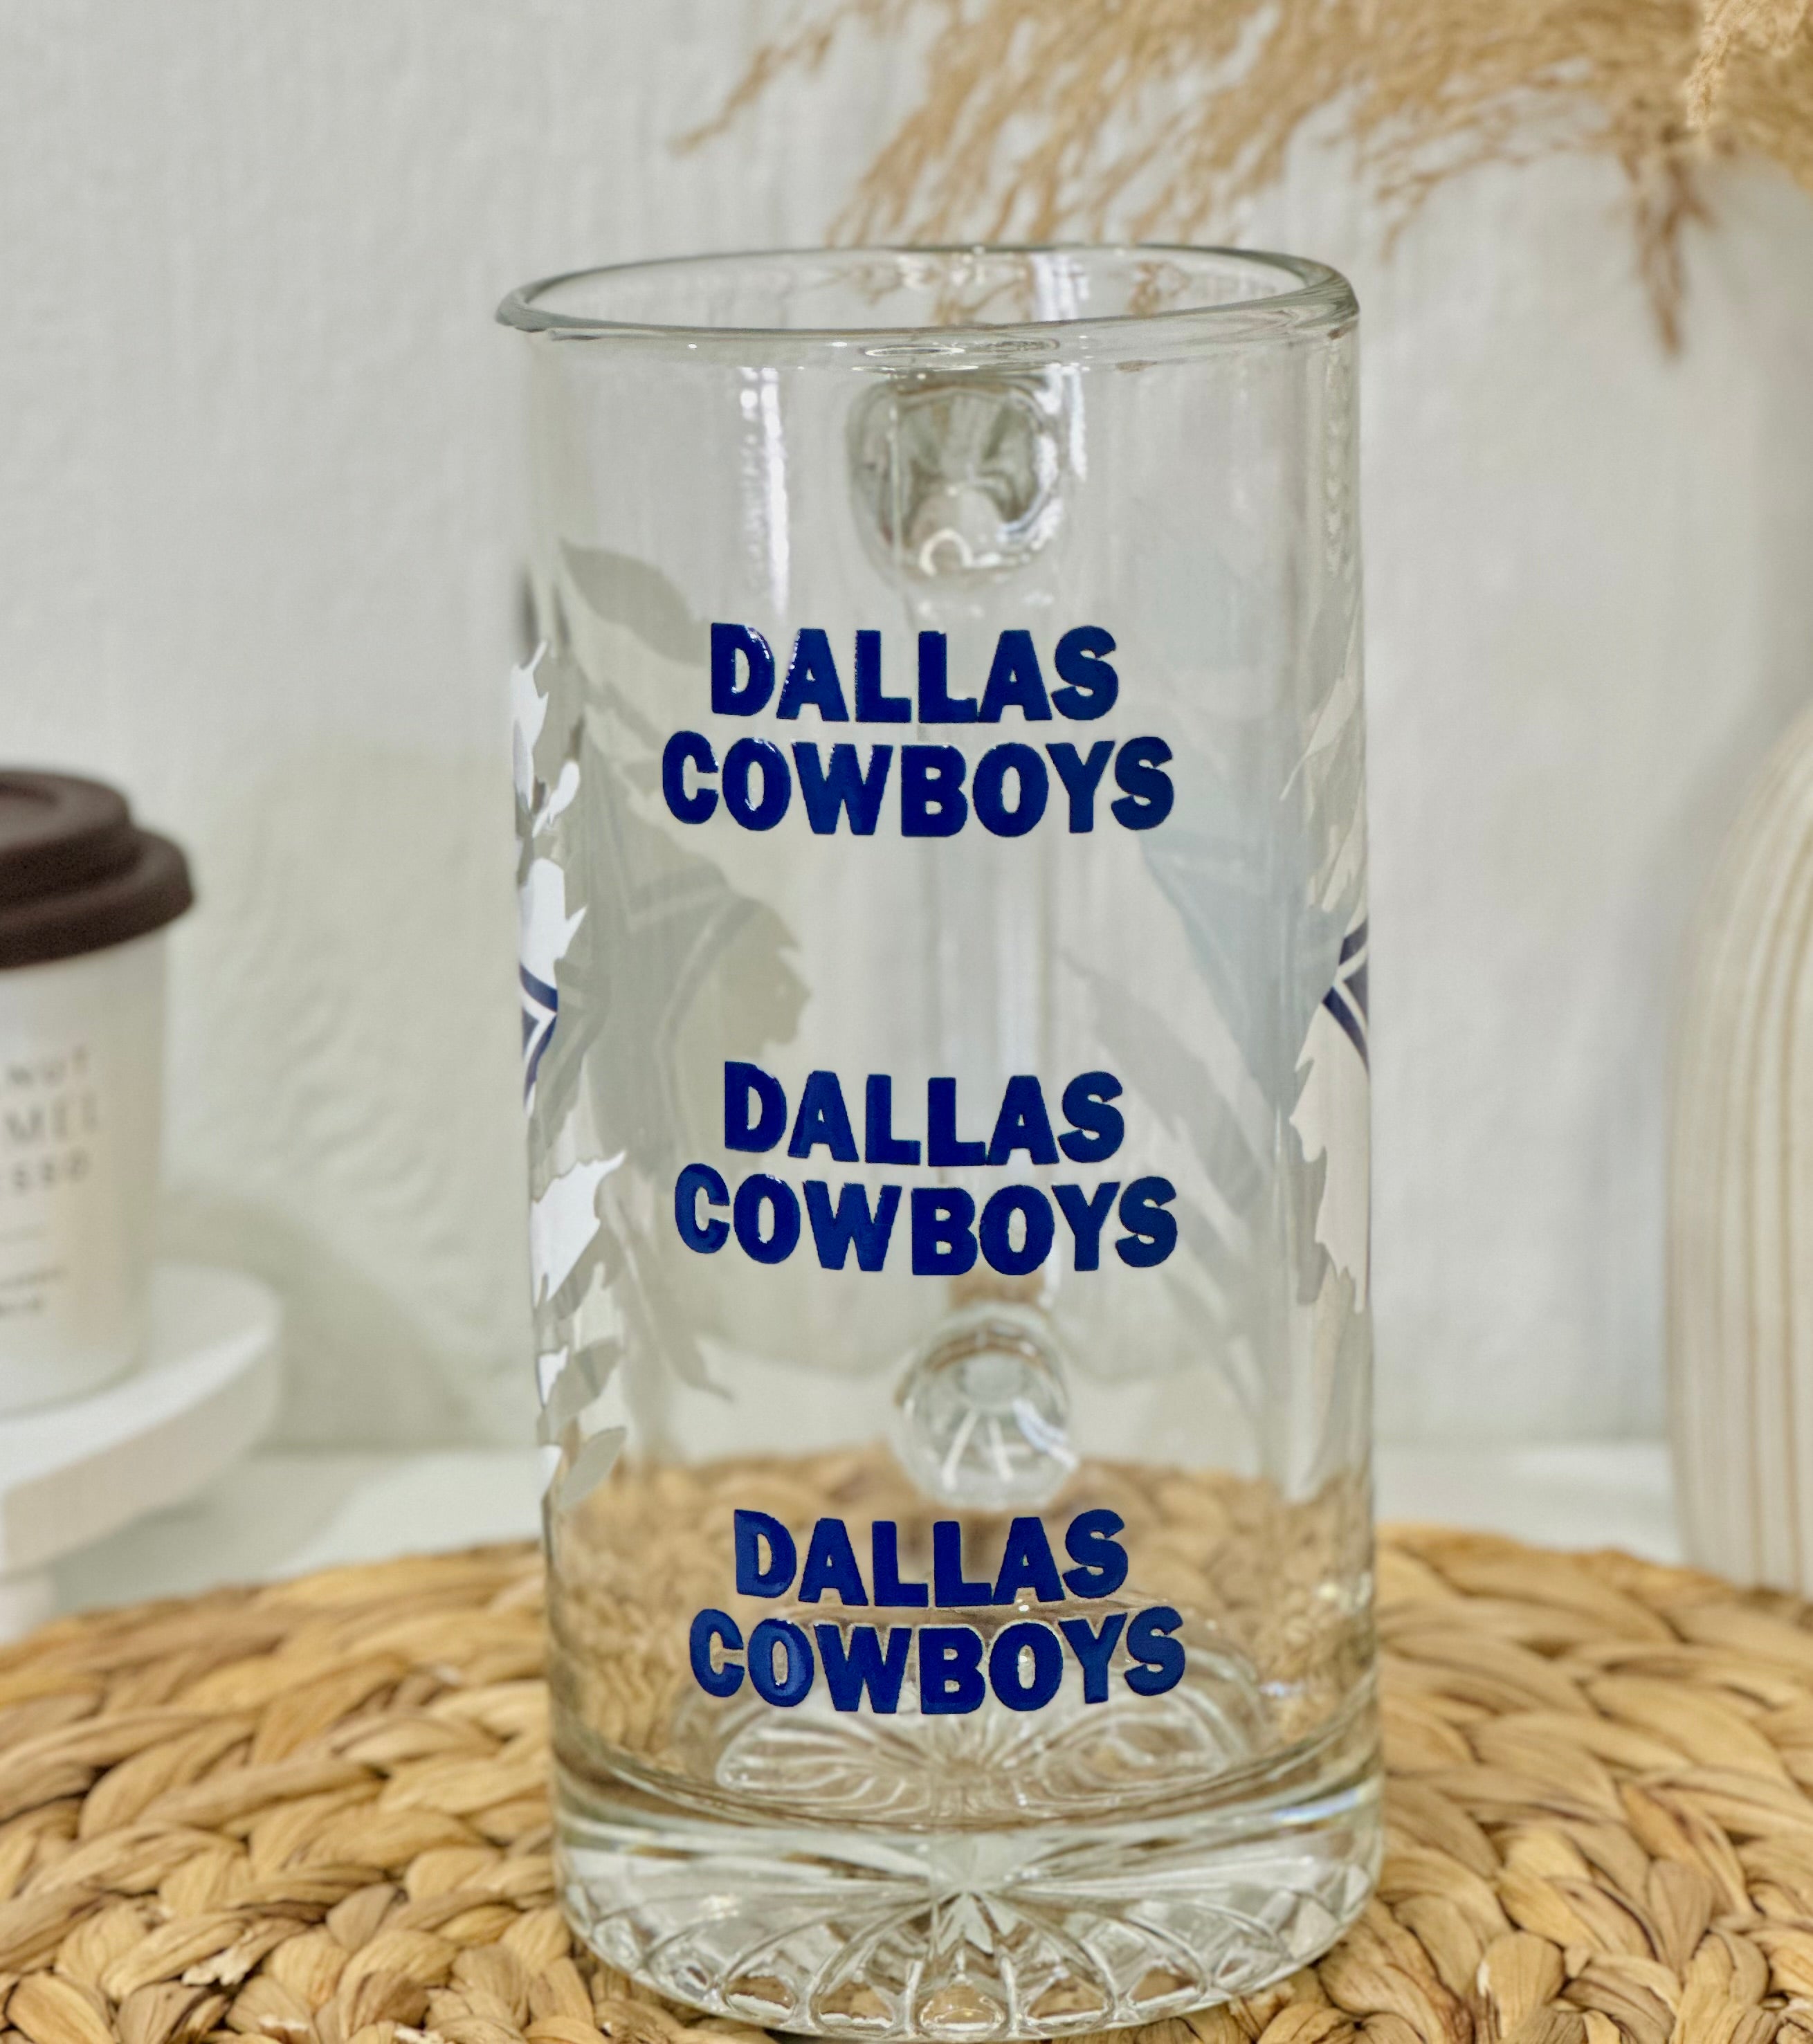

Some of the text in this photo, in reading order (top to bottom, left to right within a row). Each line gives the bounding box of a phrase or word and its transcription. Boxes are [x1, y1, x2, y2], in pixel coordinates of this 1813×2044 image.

[711, 623, 1119, 723] DALLAS
[662, 731, 1174, 837] COWBOYS
[725, 1061, 1124, 1167] DALLAS
[675, 1163, 1177, 1276] COWBOYS
[735, 1510, 1128, 1607] DALLAS
[690, 1607, 1185, 1714] COWBOYS
